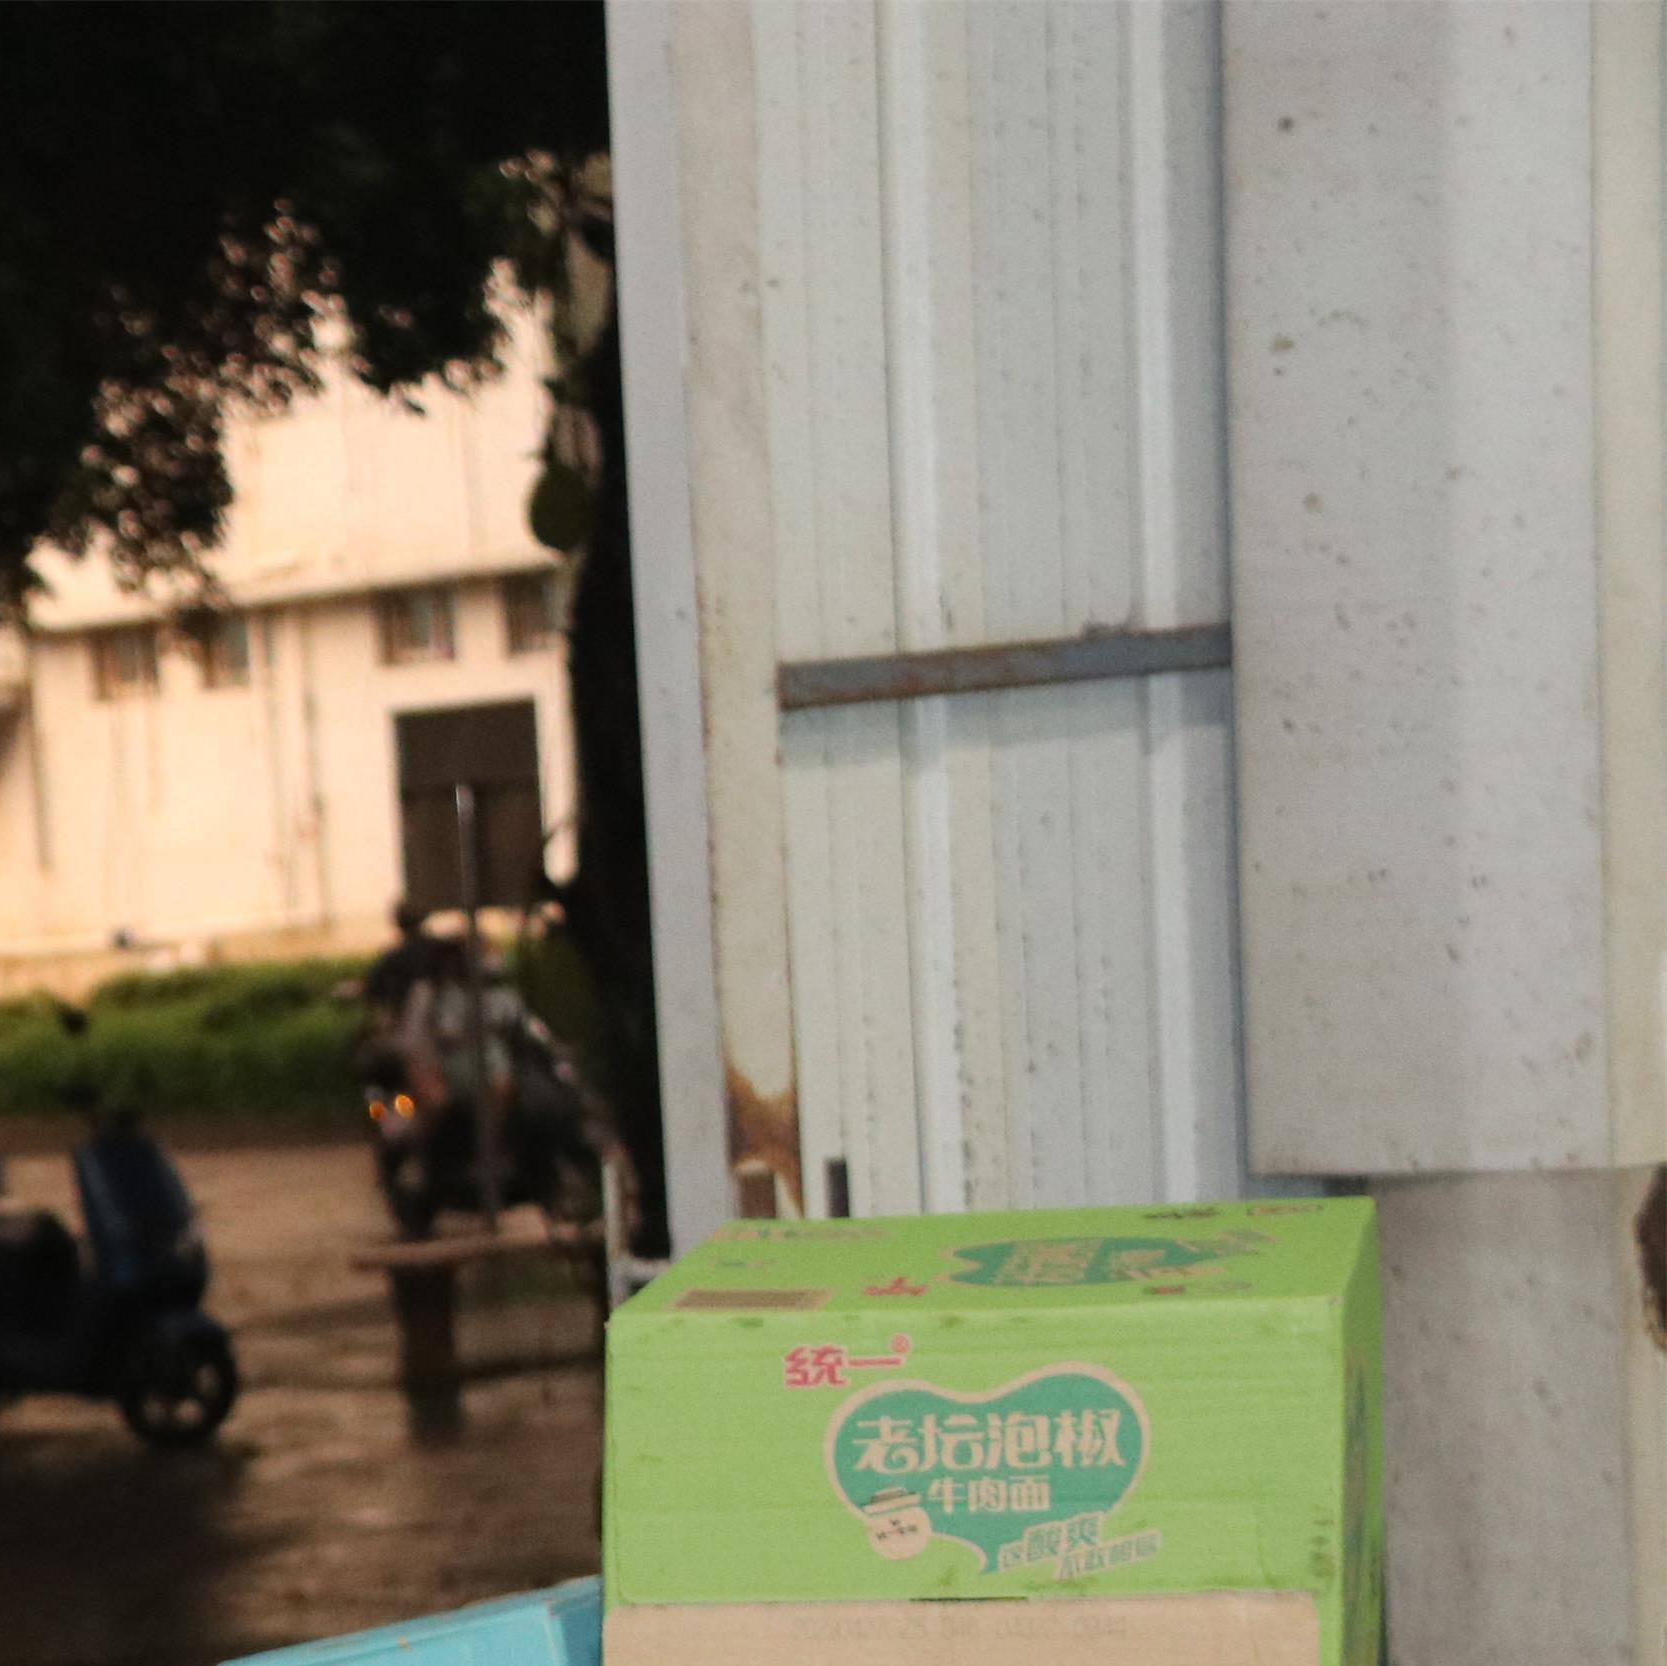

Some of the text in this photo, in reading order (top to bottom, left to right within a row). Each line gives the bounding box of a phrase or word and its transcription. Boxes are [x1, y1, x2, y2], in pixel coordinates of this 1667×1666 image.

[784, 1344, 903, 1388] 统一
[852, 1408, 1126, 1474] 老坛泡椒
[928, 1475, 1051, 1514] 牛肉面
